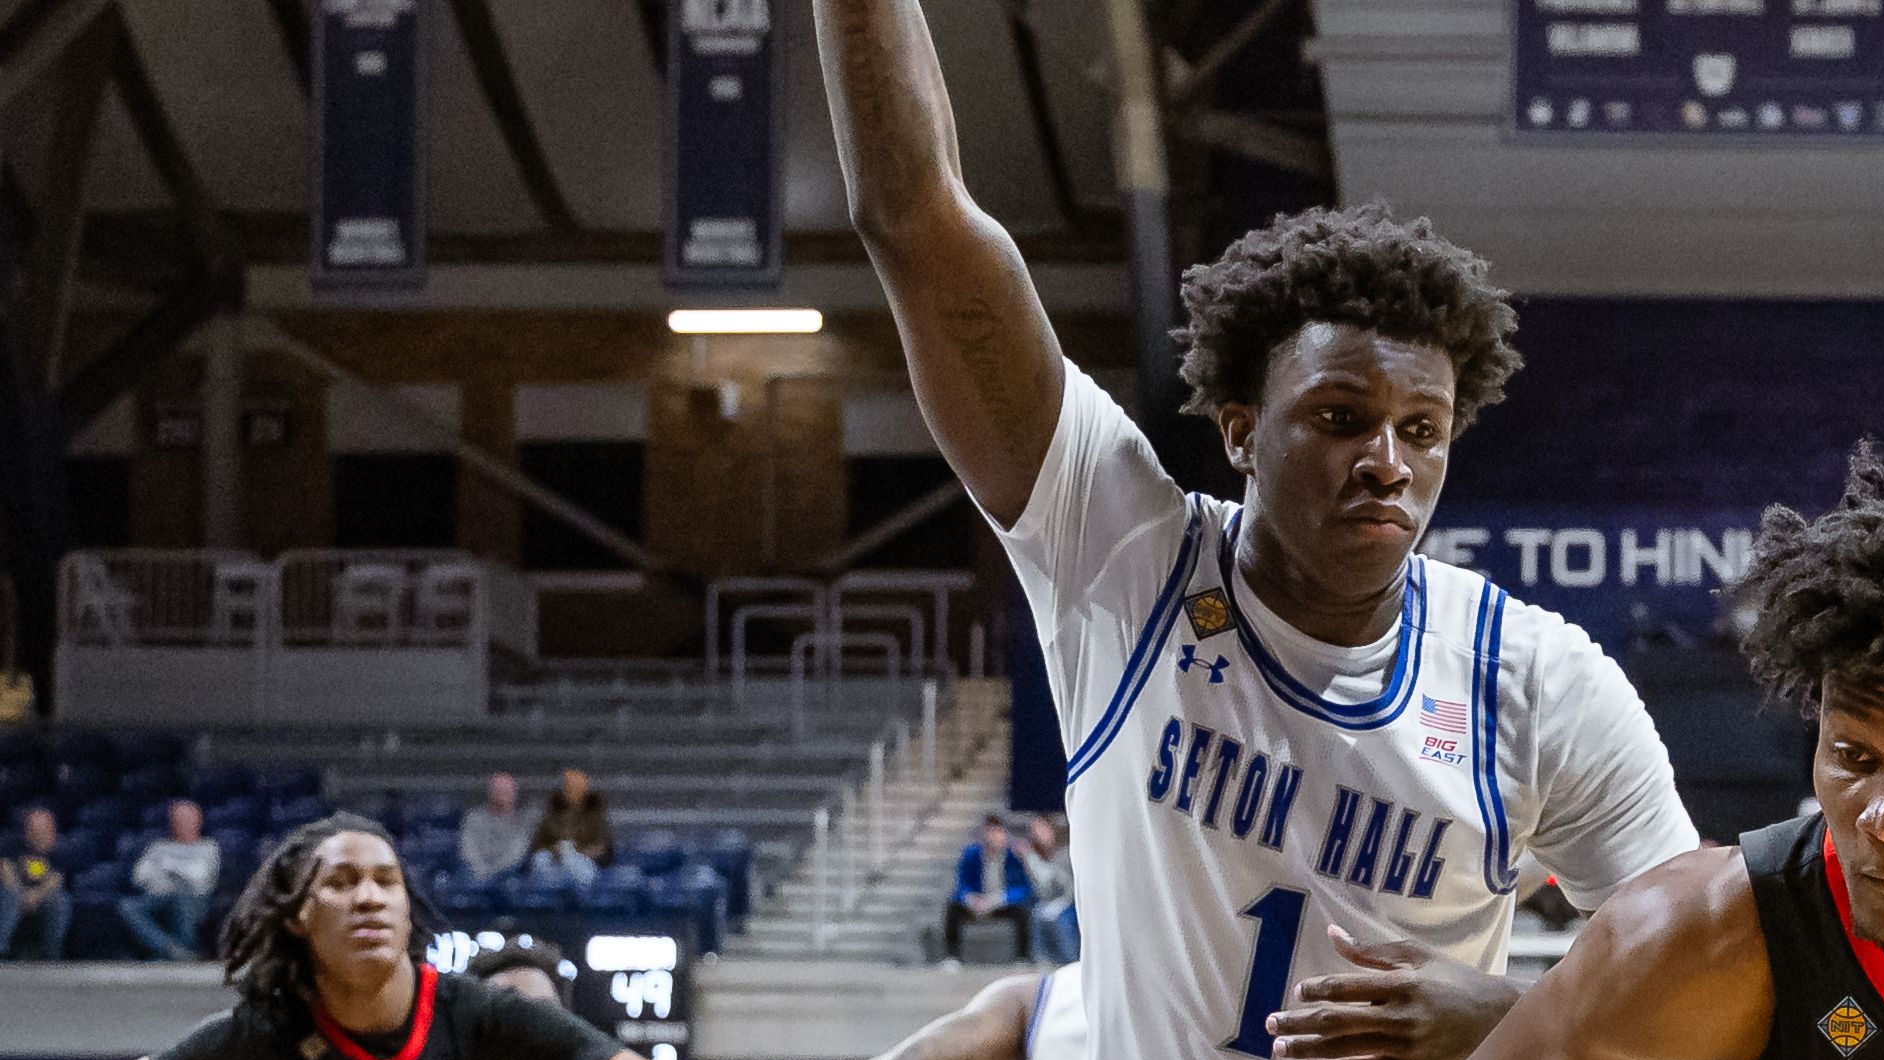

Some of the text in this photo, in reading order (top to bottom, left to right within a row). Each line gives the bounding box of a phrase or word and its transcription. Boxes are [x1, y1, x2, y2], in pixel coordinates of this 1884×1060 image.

[1506, 528, 1606, 588] TO
[1424, 736, 1457, 752] BIG
[1421, 746, 1468, 765] EAST
[1147, 716, 1453, 899] SETON HALL
[1830, 1019, 1865, 1034] NIT
